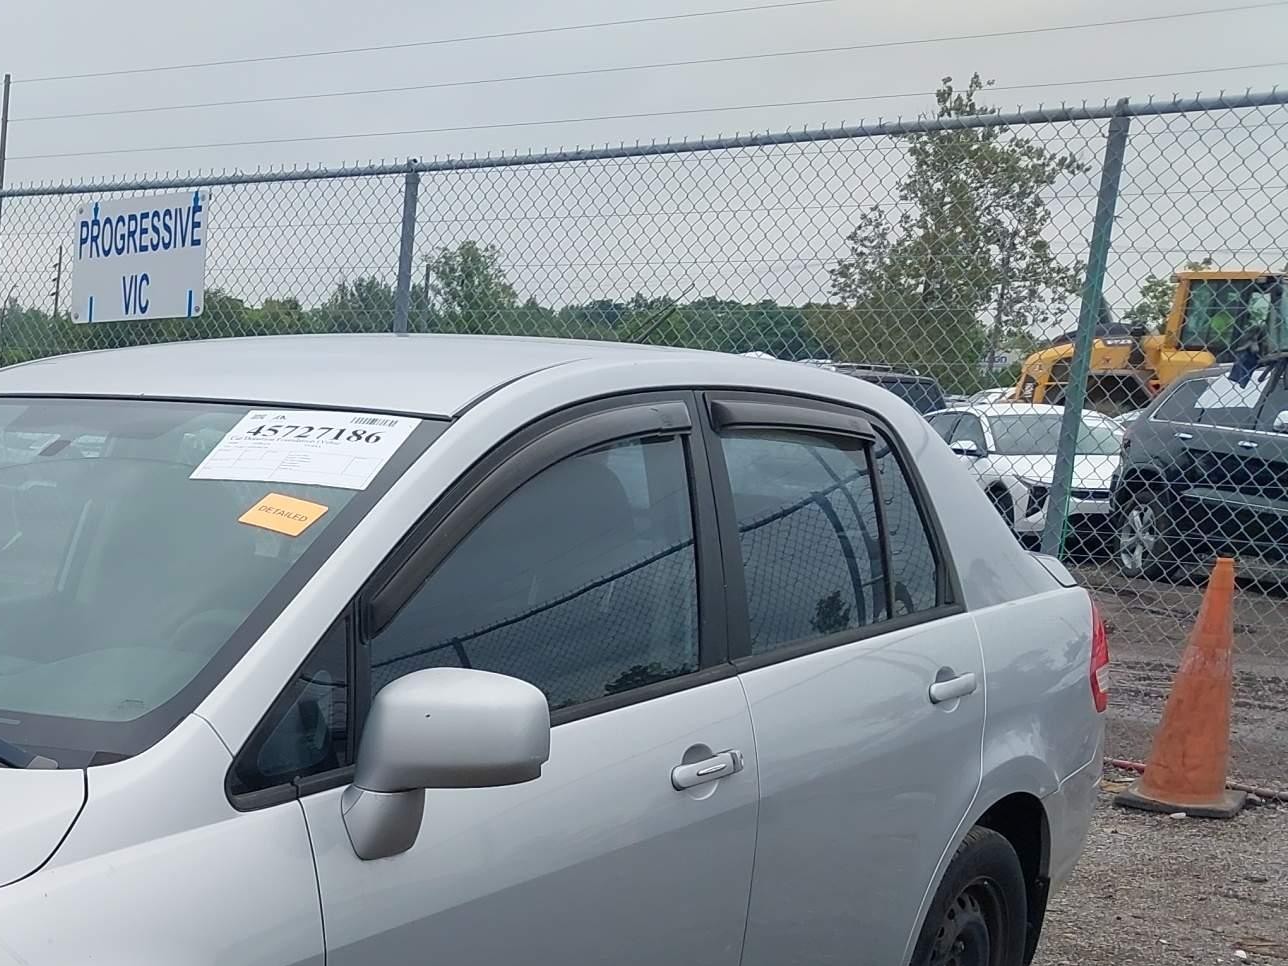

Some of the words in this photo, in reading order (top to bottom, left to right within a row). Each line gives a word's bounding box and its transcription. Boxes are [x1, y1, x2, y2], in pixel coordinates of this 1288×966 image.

[78, 204, 203, 260] PROGRESSIVE
[122, 272, 150, 315] VIC
[246, 423, 385, 445] 45727186
[258, 504, 309, 523] DETAILED
